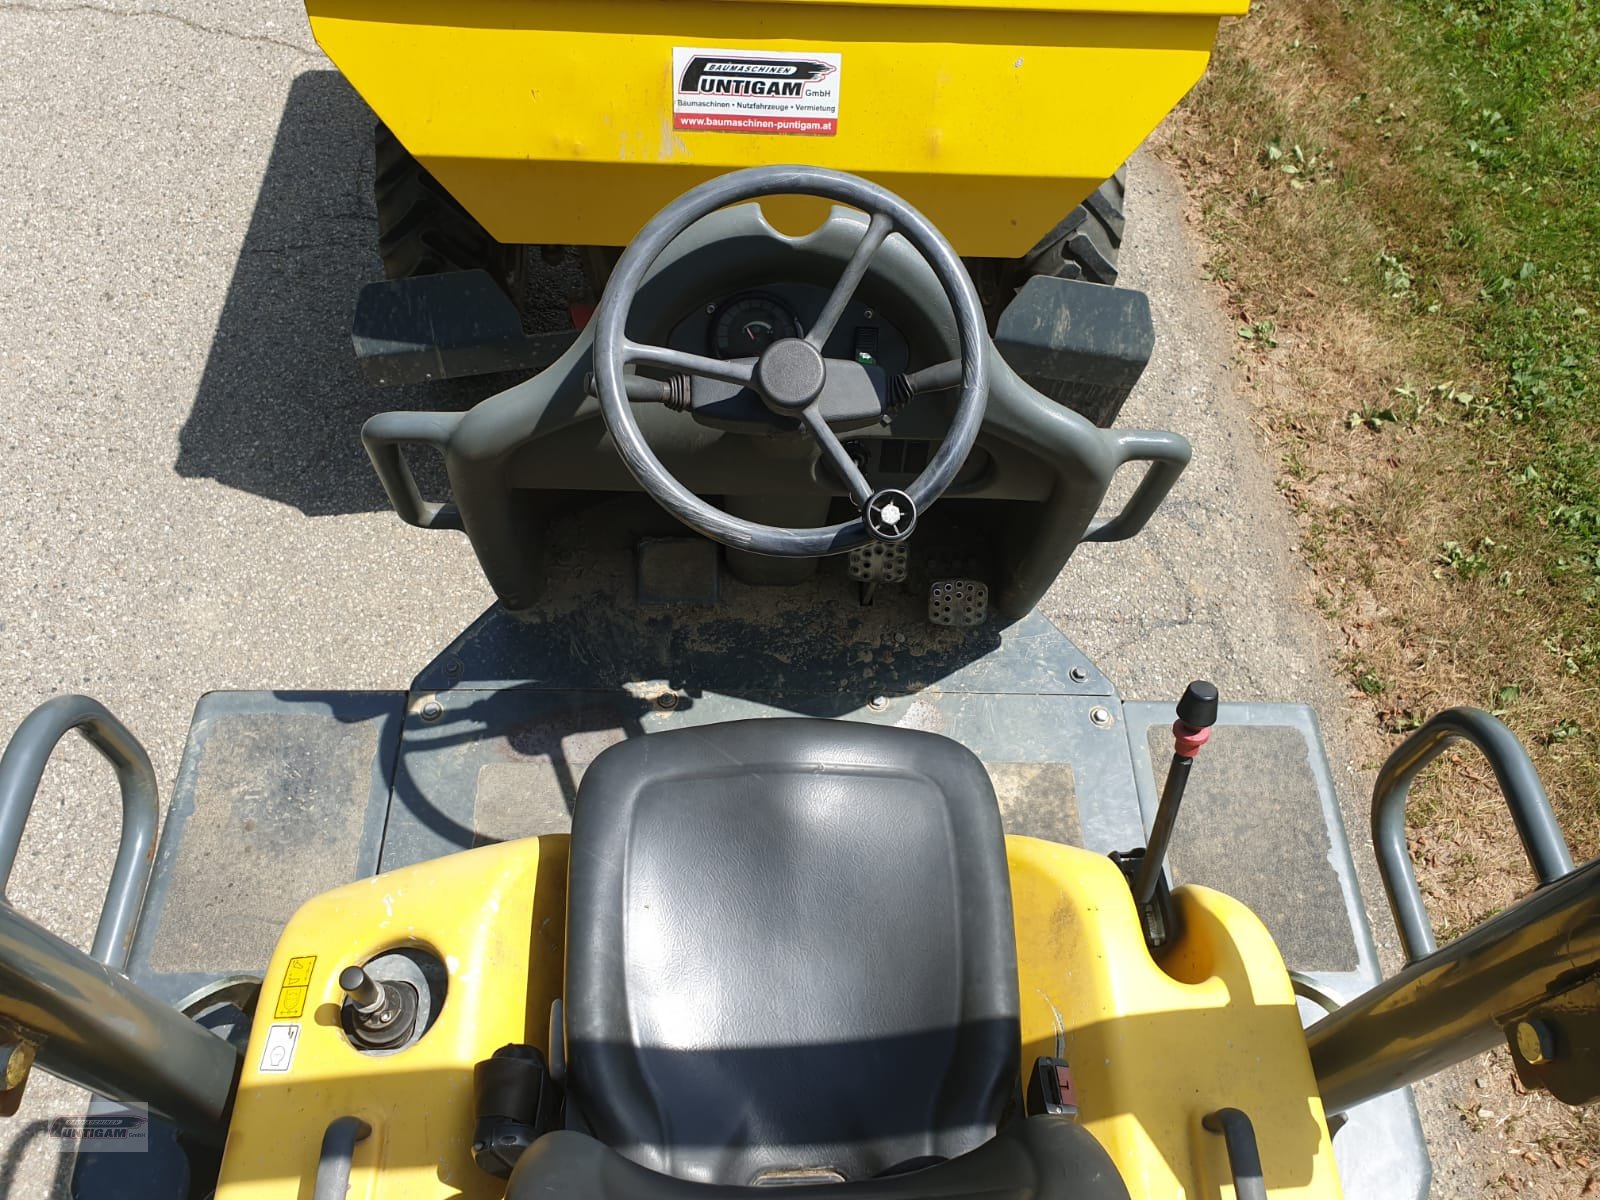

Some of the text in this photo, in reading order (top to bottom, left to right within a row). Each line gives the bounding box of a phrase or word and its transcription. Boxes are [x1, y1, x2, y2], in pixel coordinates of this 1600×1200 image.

[708, 64, 792, 74] BAUMASCHINEN
[677, 99, 836, 113] Baumaschinen Nutzfahrzeuge Vermietung
[680, 117, 832, 131] www.baumaschinen-puntigam.at
